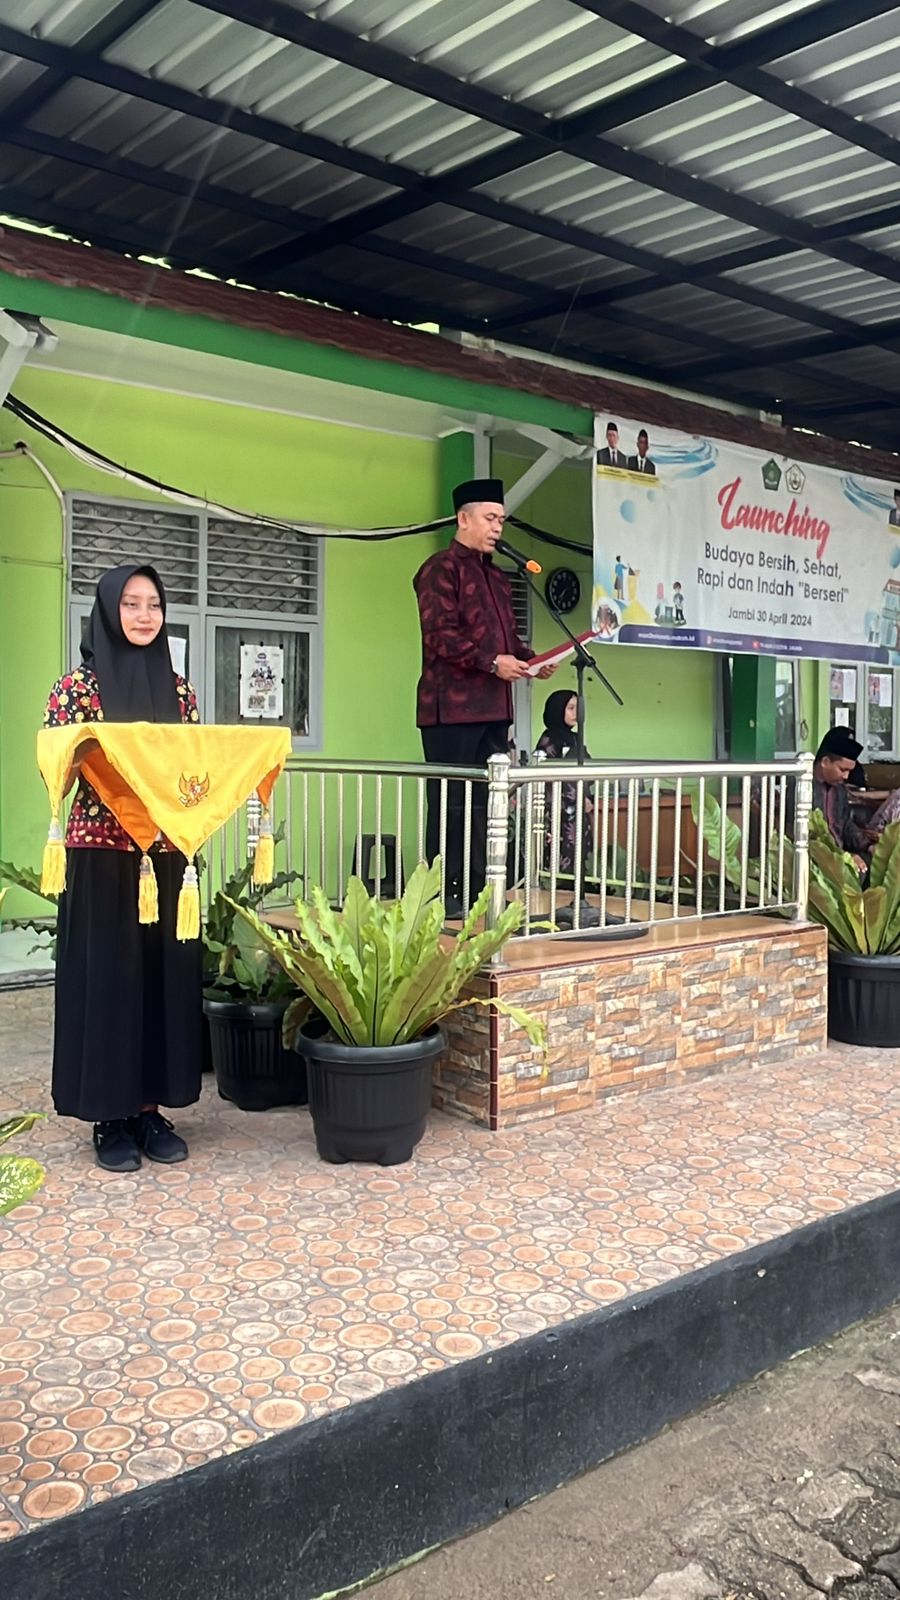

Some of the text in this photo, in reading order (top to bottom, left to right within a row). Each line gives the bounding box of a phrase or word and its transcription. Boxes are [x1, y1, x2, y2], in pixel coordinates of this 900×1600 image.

[718, 476, 831, 560] Launching
[705, 542, 842, 580] Budaya Bersih, Sehat,
[697, 567, 724, 590] Rapi
[727, 572, 753, 592] dan
[757, 576, 794, 597] Indah
[728, 607, 812, 626] Jambi 30 April 2024
